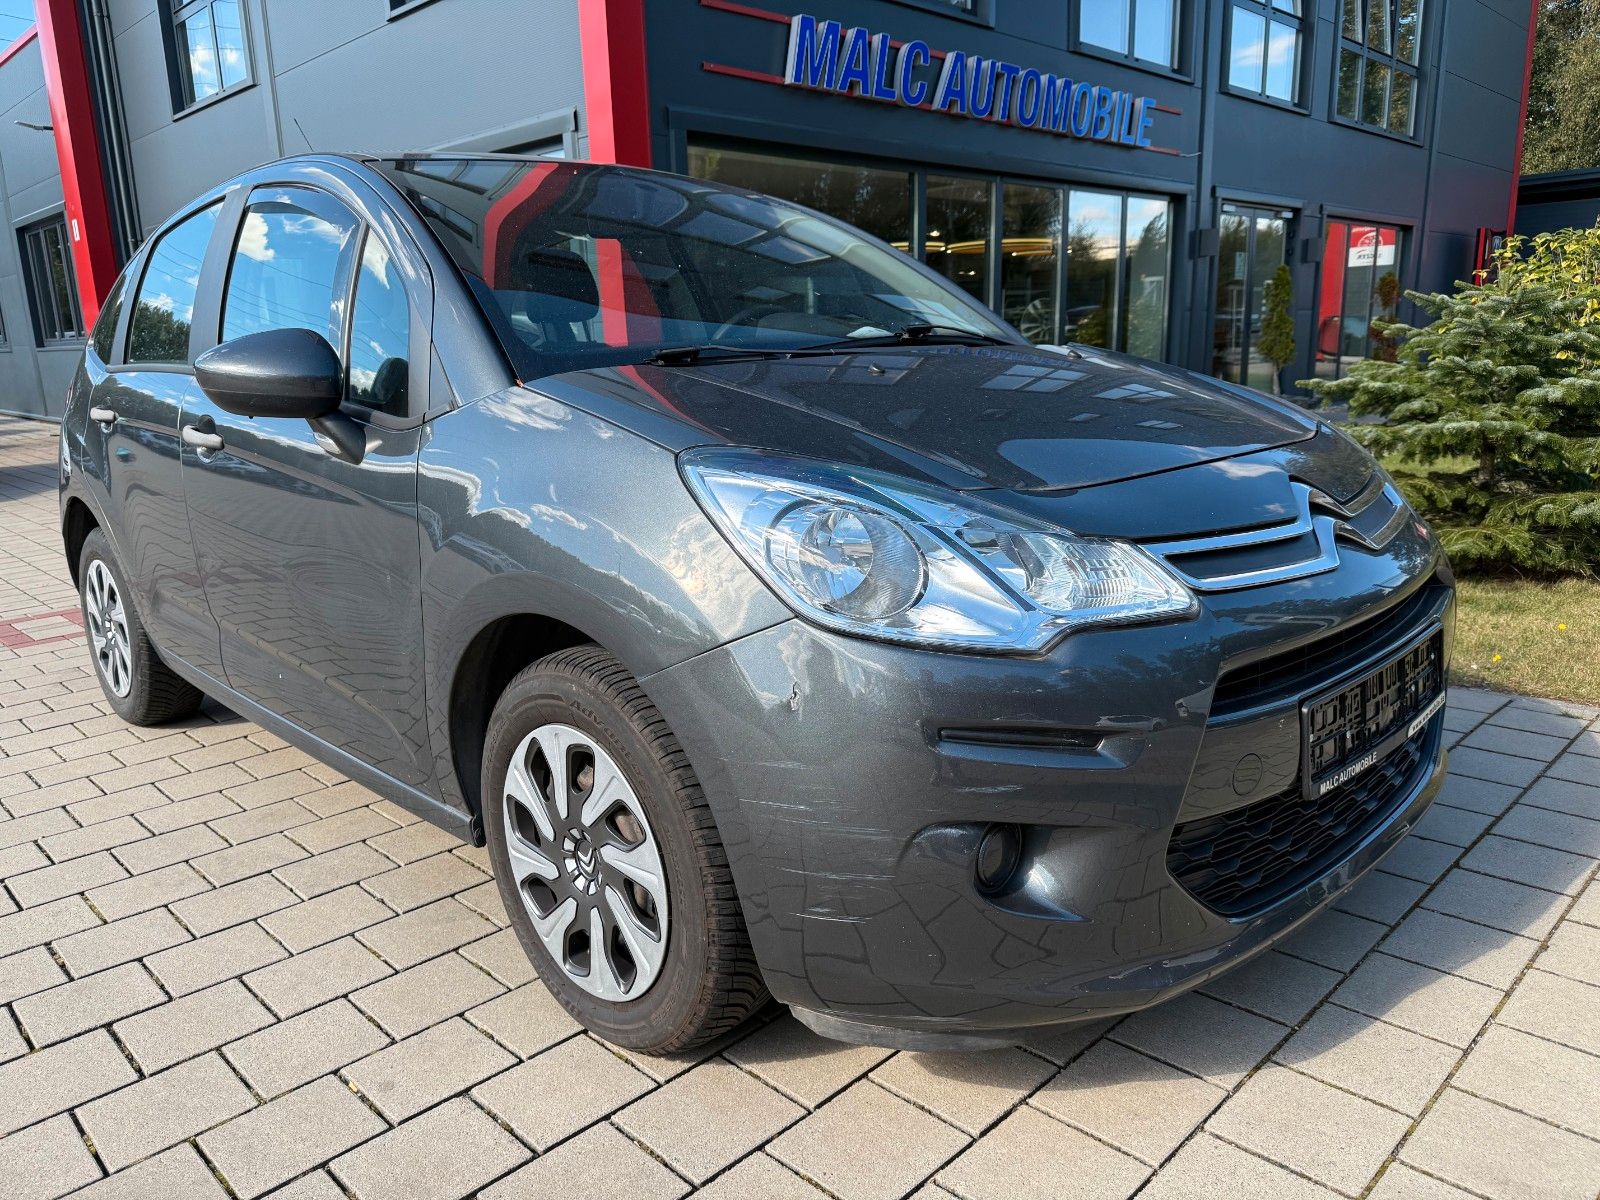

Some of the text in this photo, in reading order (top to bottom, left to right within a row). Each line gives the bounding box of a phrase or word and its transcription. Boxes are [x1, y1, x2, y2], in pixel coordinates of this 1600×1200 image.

[786, 13, 1157, 147] MALC AUTOMOBILE
[1319, 751, 1377, 795] MALC AUTOMOBILE
